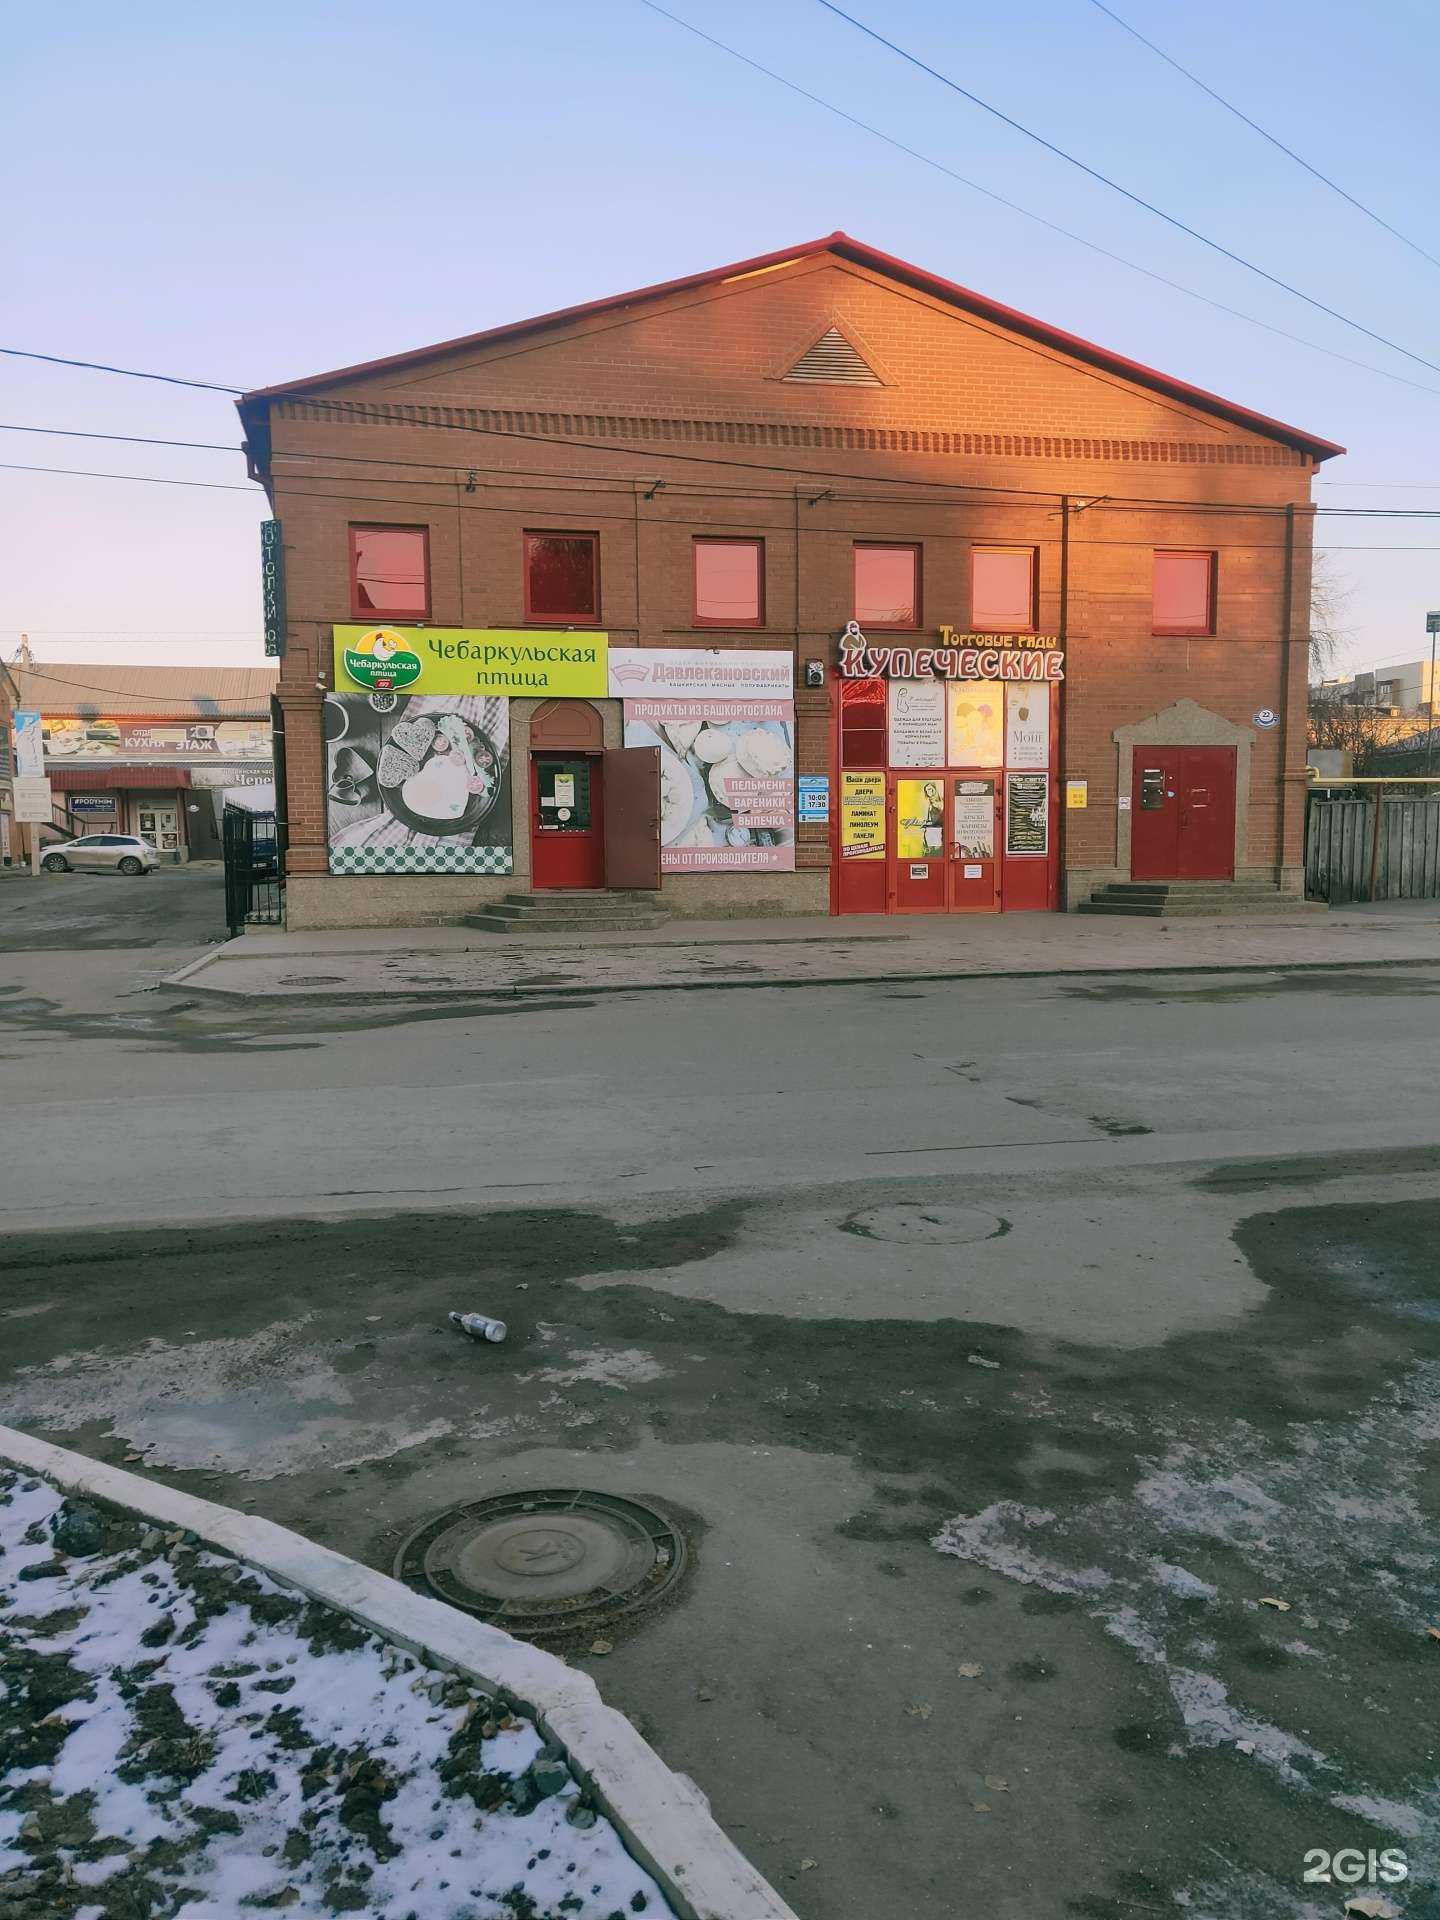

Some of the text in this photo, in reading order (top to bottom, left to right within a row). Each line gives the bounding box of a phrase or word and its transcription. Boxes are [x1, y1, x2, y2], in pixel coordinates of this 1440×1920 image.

[428, 639, 596, 666] Чебаркульская
[350, 658, 417, 672] Чебаркульская
[840, 647, 1065, 681] КУПЕЧЕСКИЕ
[370, 670, 397, 678] птица
[652, 662, 790, 683] Давлекановский
[476, 670, 549, 688] птица
[635, 704, 783, 717] ПРОДУКТЫ ИЗ БАШКОРТОСТАНА
[125, 738, 213, 750] КУХНЯ ЭТАЖ
[731, 781, 785, 790] ПЕЛЬМЕНИ
[734, 797, 785, 808] ВАРЕНИКИ
[738, 815, 785, 826] ВЫПЕЧКА
[661, 853, 769, 865] ЕНЫ ОТ ПРОИЗВОДИТЕЛЯ
